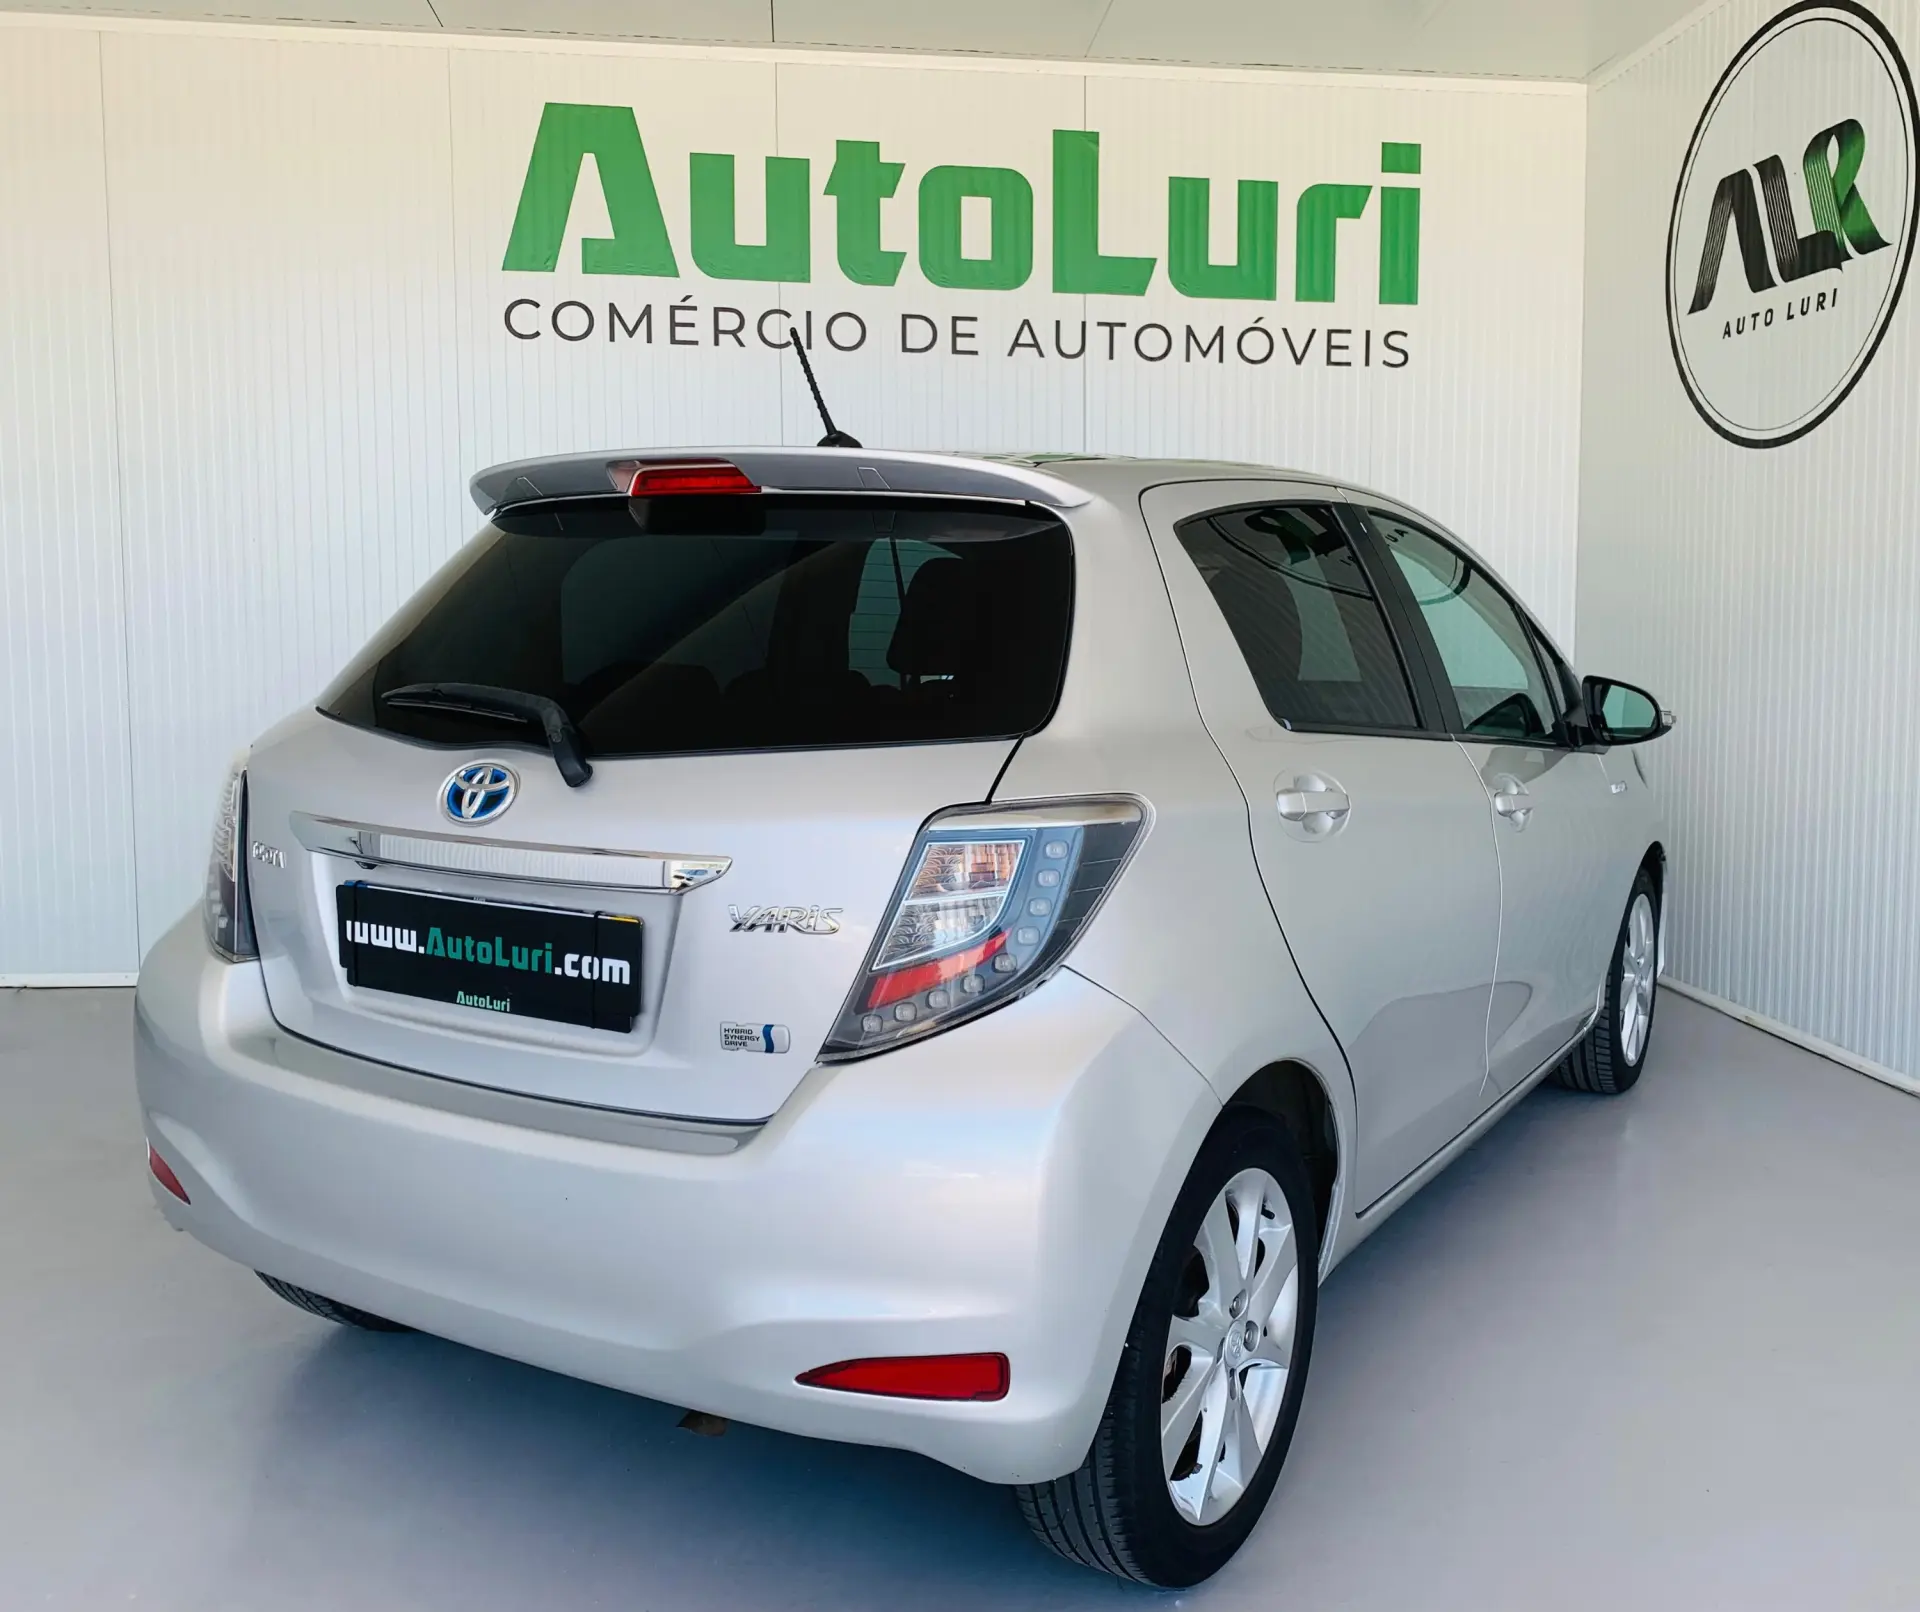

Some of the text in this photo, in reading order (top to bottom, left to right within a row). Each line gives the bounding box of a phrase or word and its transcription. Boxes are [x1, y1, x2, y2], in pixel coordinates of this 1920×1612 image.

[502, 102, 1421, 304] AutoLuri
[503, 294, 1411, 369] COMÉRCIO DE AUTOMÓVEIS
[1722, 288, 1838, 339] AUTO LURI
[346, 920, 631, 985] www.AutoLuri.com
[456, 990, 510, 1012] AutoLuri
[724, 1034, 760, 1042] SYNERGY
